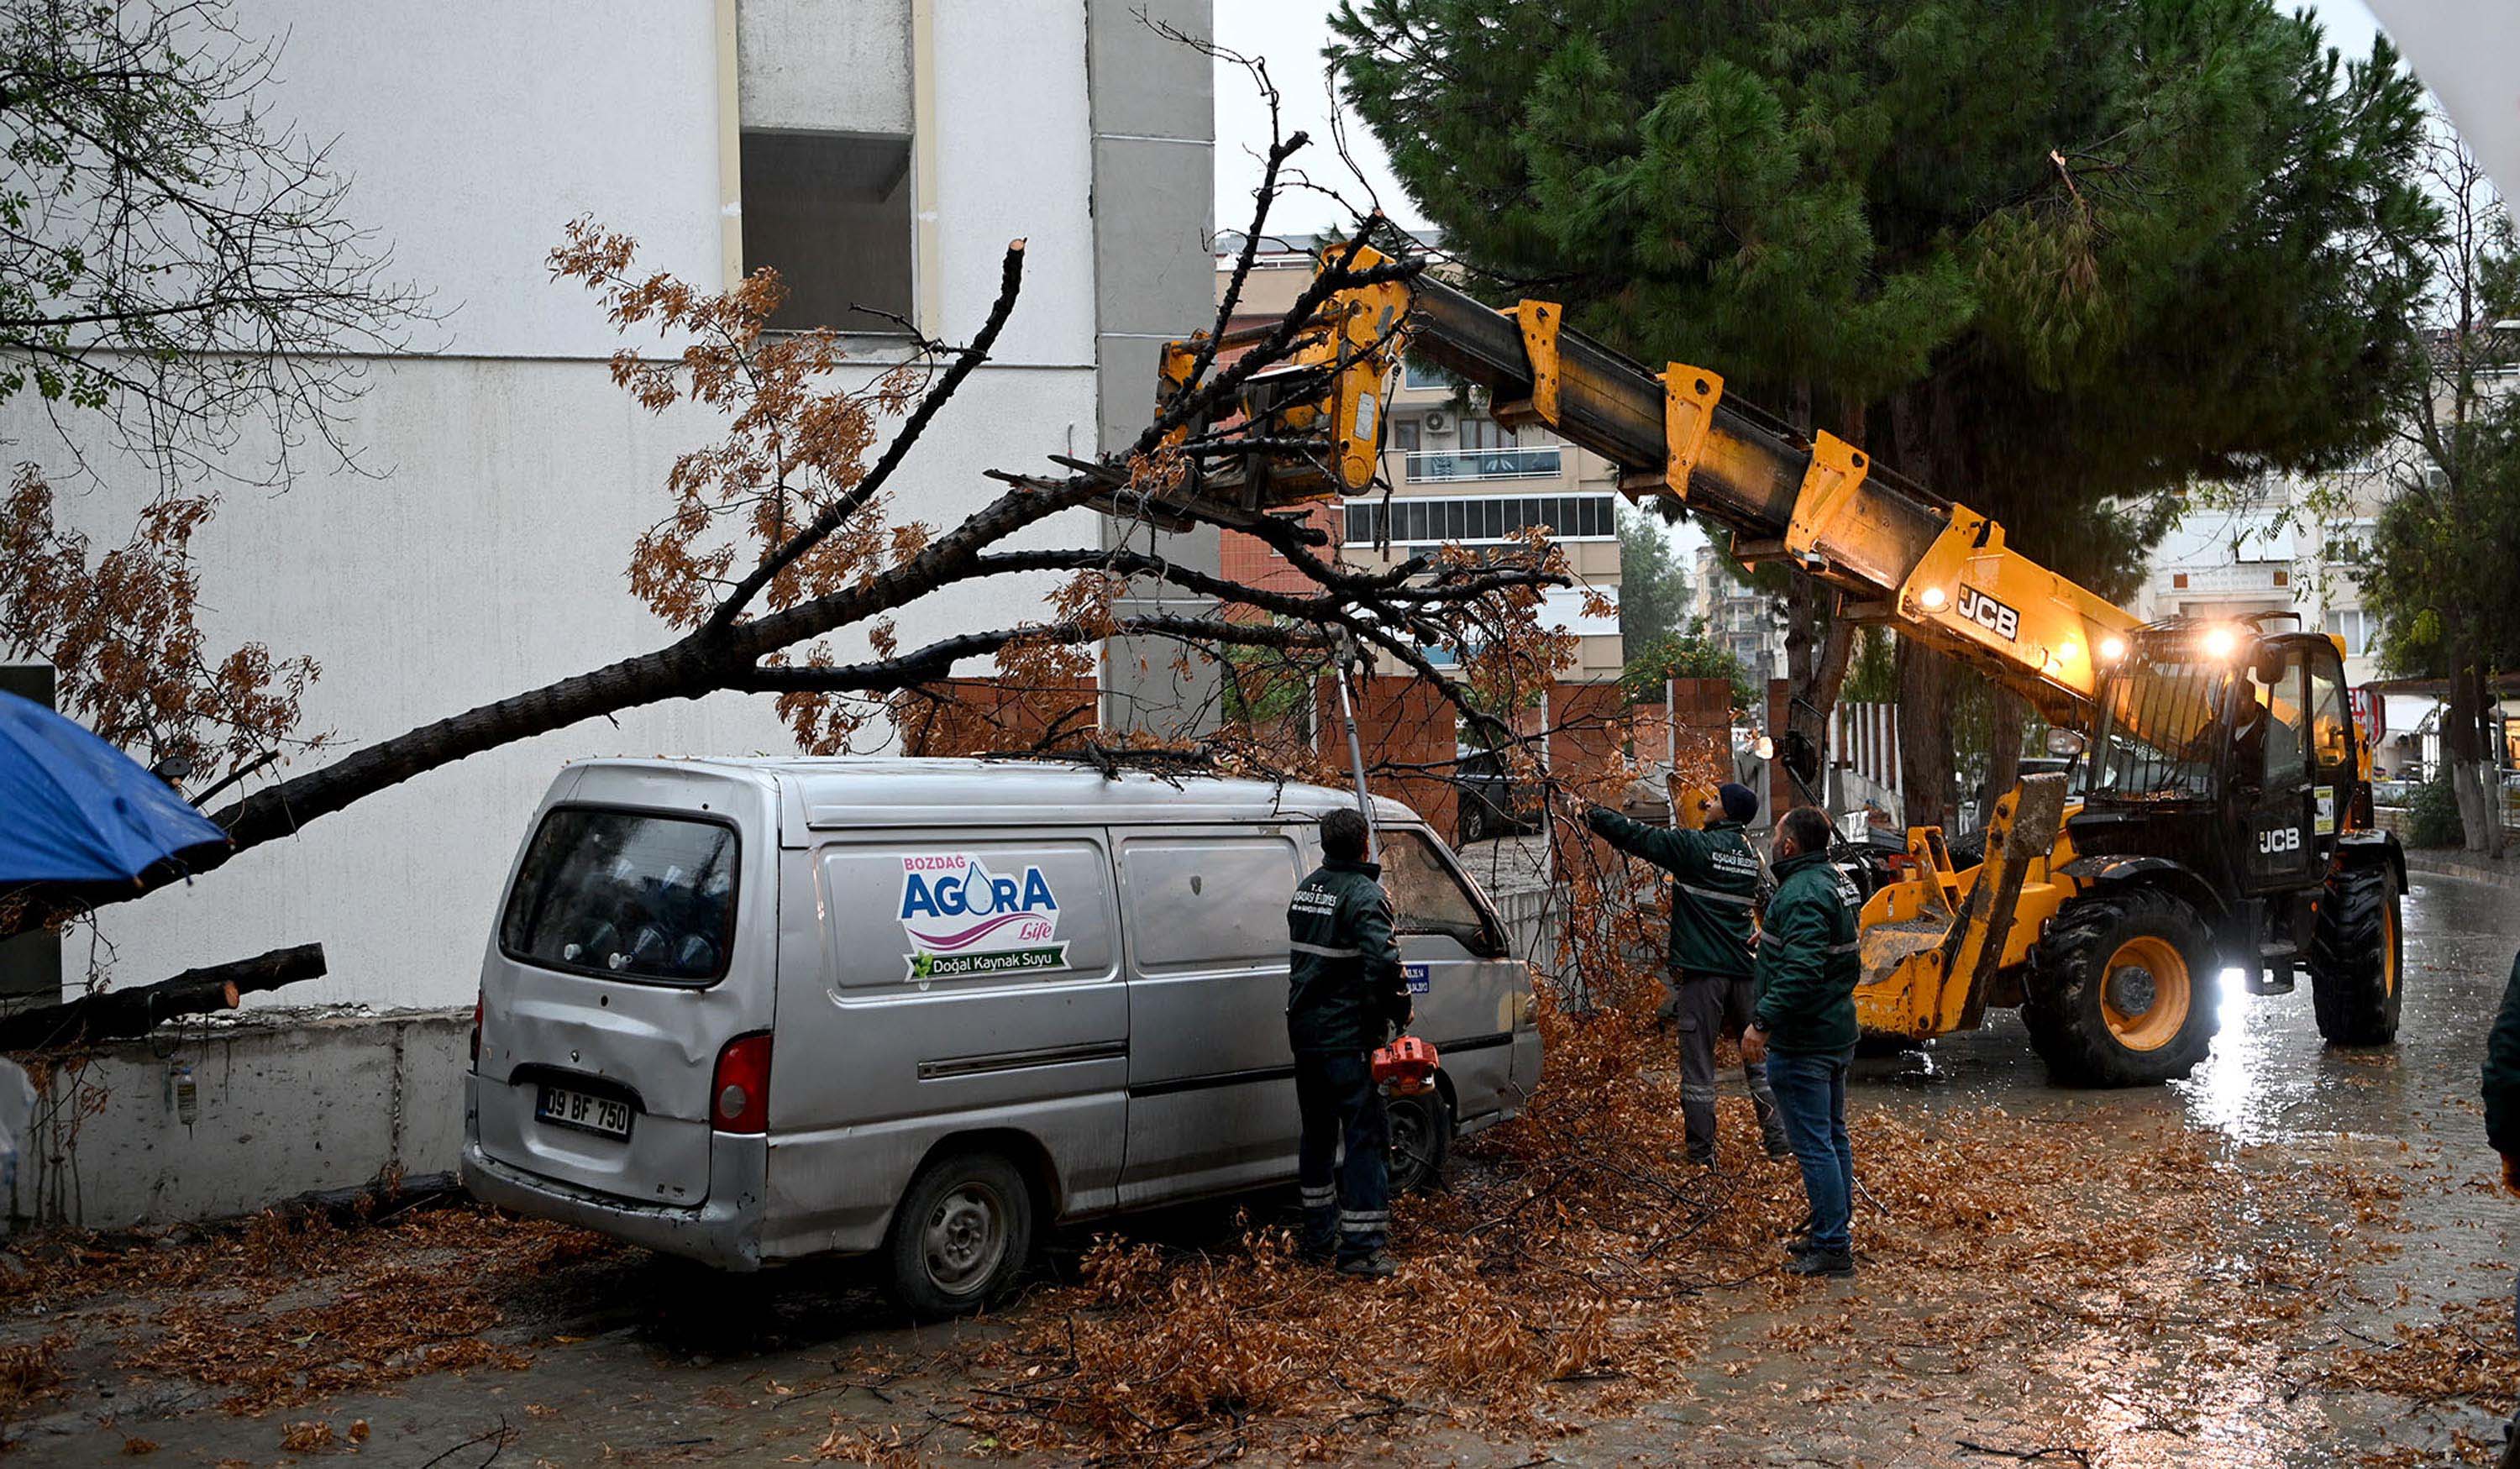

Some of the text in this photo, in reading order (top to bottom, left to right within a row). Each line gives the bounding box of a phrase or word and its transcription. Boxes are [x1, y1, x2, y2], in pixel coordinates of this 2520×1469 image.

[1958, 587, 2019, 641] JCB
[2260, 827, 2300, 853] JCB
[904, 855, 965, 870] BOZDAĞ
[901, 862, 1057, 919] AGORA
[1017, 922, 1052, 941] Life
[933, 952, 1052, 975] Doğal Kaynak Suyu
[547, 1089, 627, 1131] 09 BF 750
